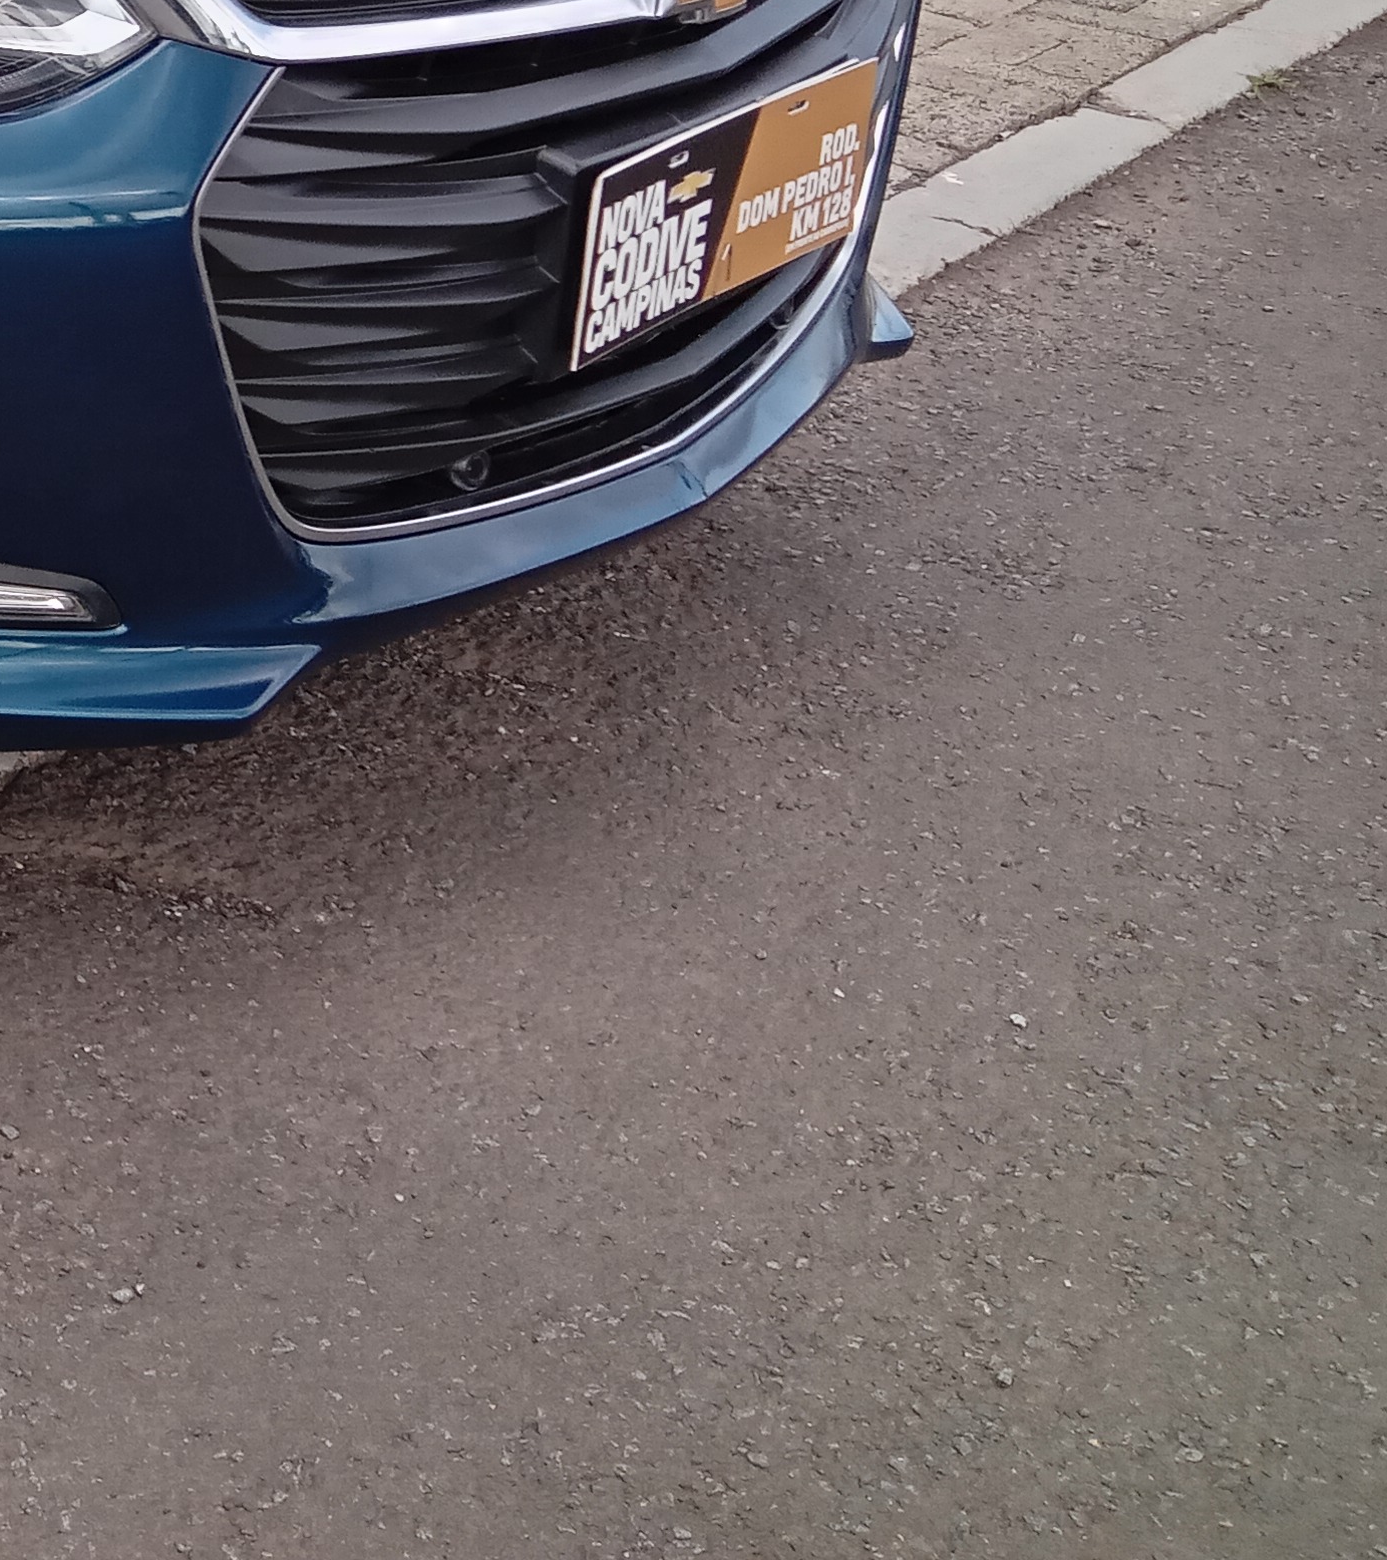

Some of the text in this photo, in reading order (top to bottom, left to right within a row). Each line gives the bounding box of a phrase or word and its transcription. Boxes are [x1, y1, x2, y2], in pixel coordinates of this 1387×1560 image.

[818, 122, 861, 167] ROD.
[597, 179, 667, 255] NOVA
[735, 186, 782, 235] DOM
[781, 160, 844, 215] PEDRO
[788, 200, 822, 242] KM
[822, 186, 854, 227] 128
[591, 198, 714, 311] CODIVE
[583, 258, 704, 354] CAMPINAS
